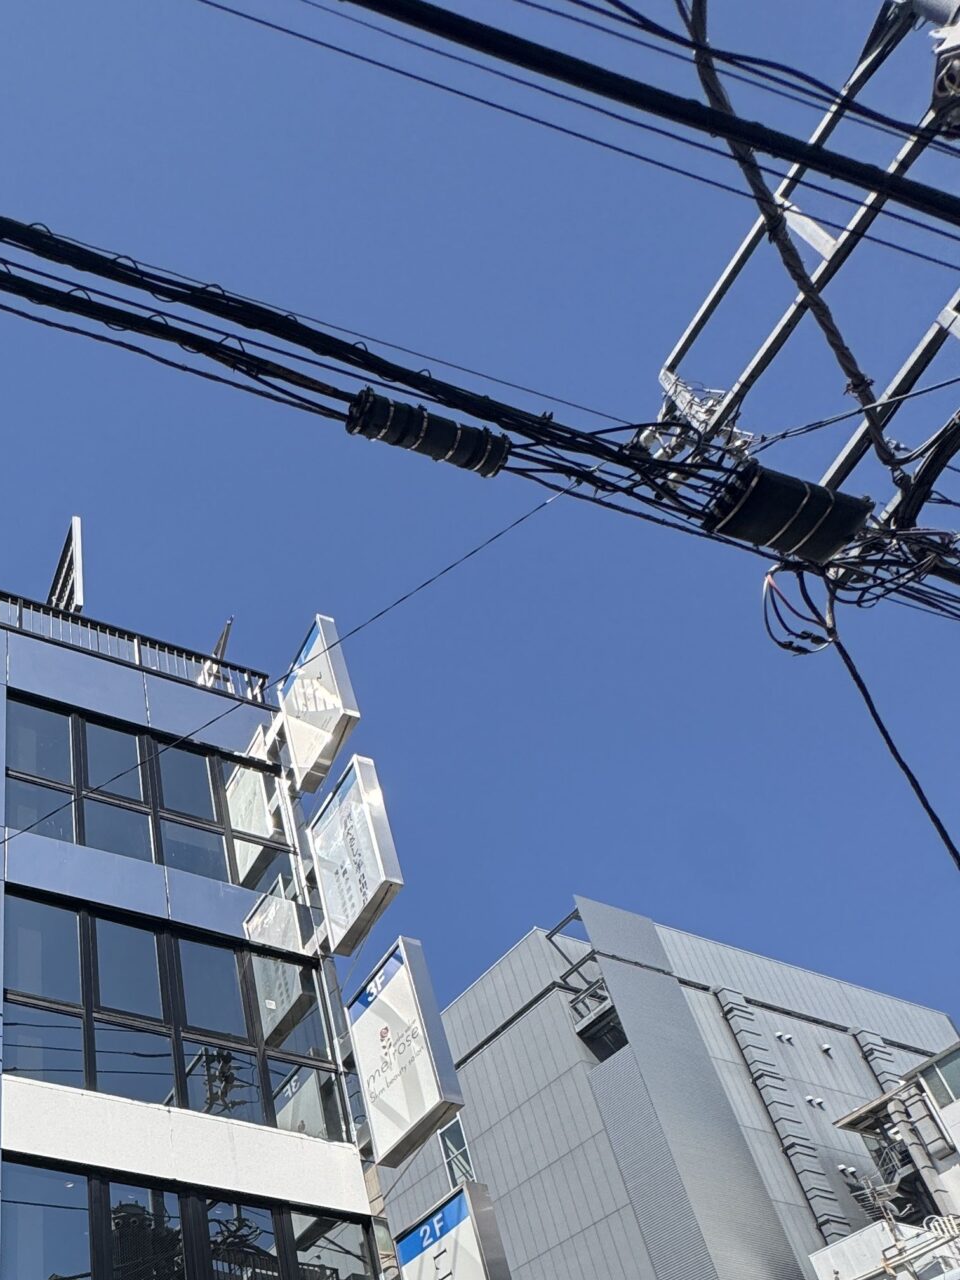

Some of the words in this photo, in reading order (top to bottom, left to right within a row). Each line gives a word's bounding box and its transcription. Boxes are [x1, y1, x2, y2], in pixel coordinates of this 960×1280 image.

[365, 970, 386, 1002] 3F
[384, 1065, 407, 1088] beauty
[419, 1213, 445, 1248] 2F
